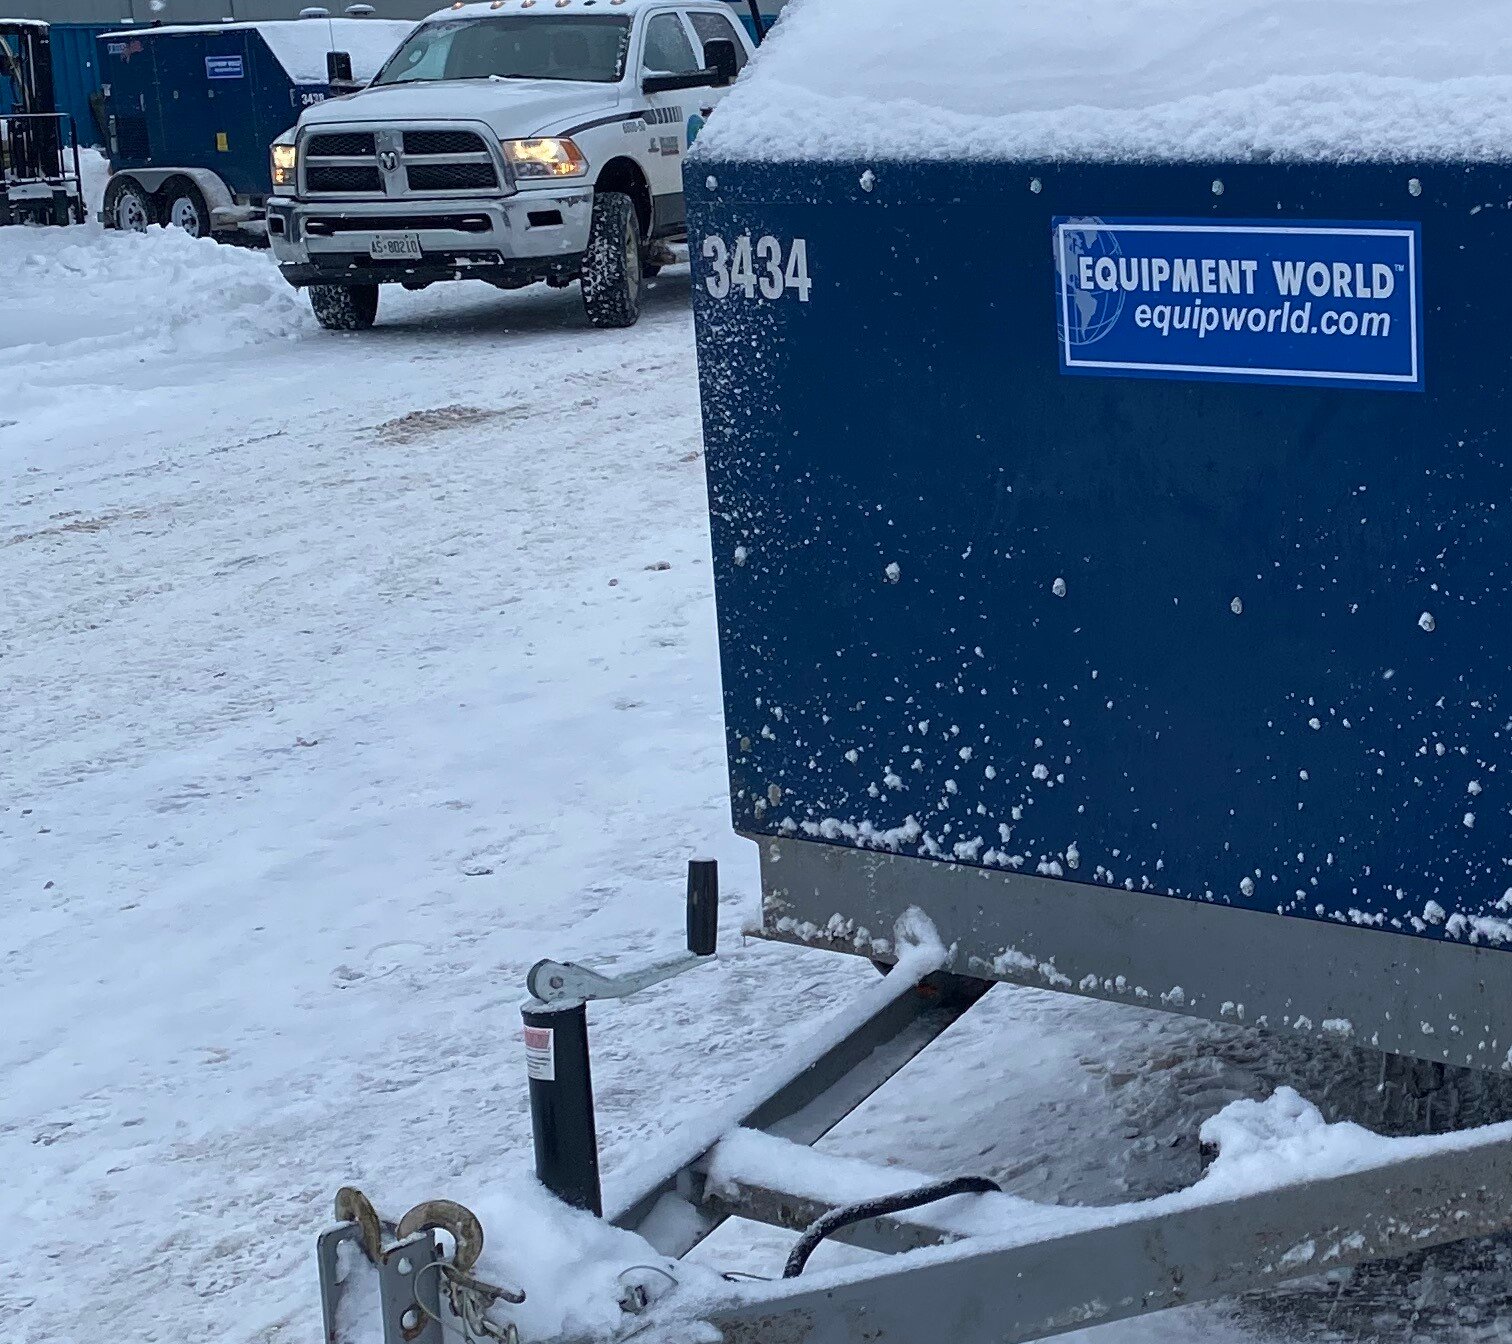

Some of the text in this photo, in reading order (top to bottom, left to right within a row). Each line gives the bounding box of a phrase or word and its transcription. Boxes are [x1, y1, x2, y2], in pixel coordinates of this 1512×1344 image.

[702, 235, 813, 302] 3434
[1078, 256, 1258, 296] EQUIPMENT
[1272, 260, 1395, 299] WORLD
[1134, 298, 1391, 339] equipworld.com
